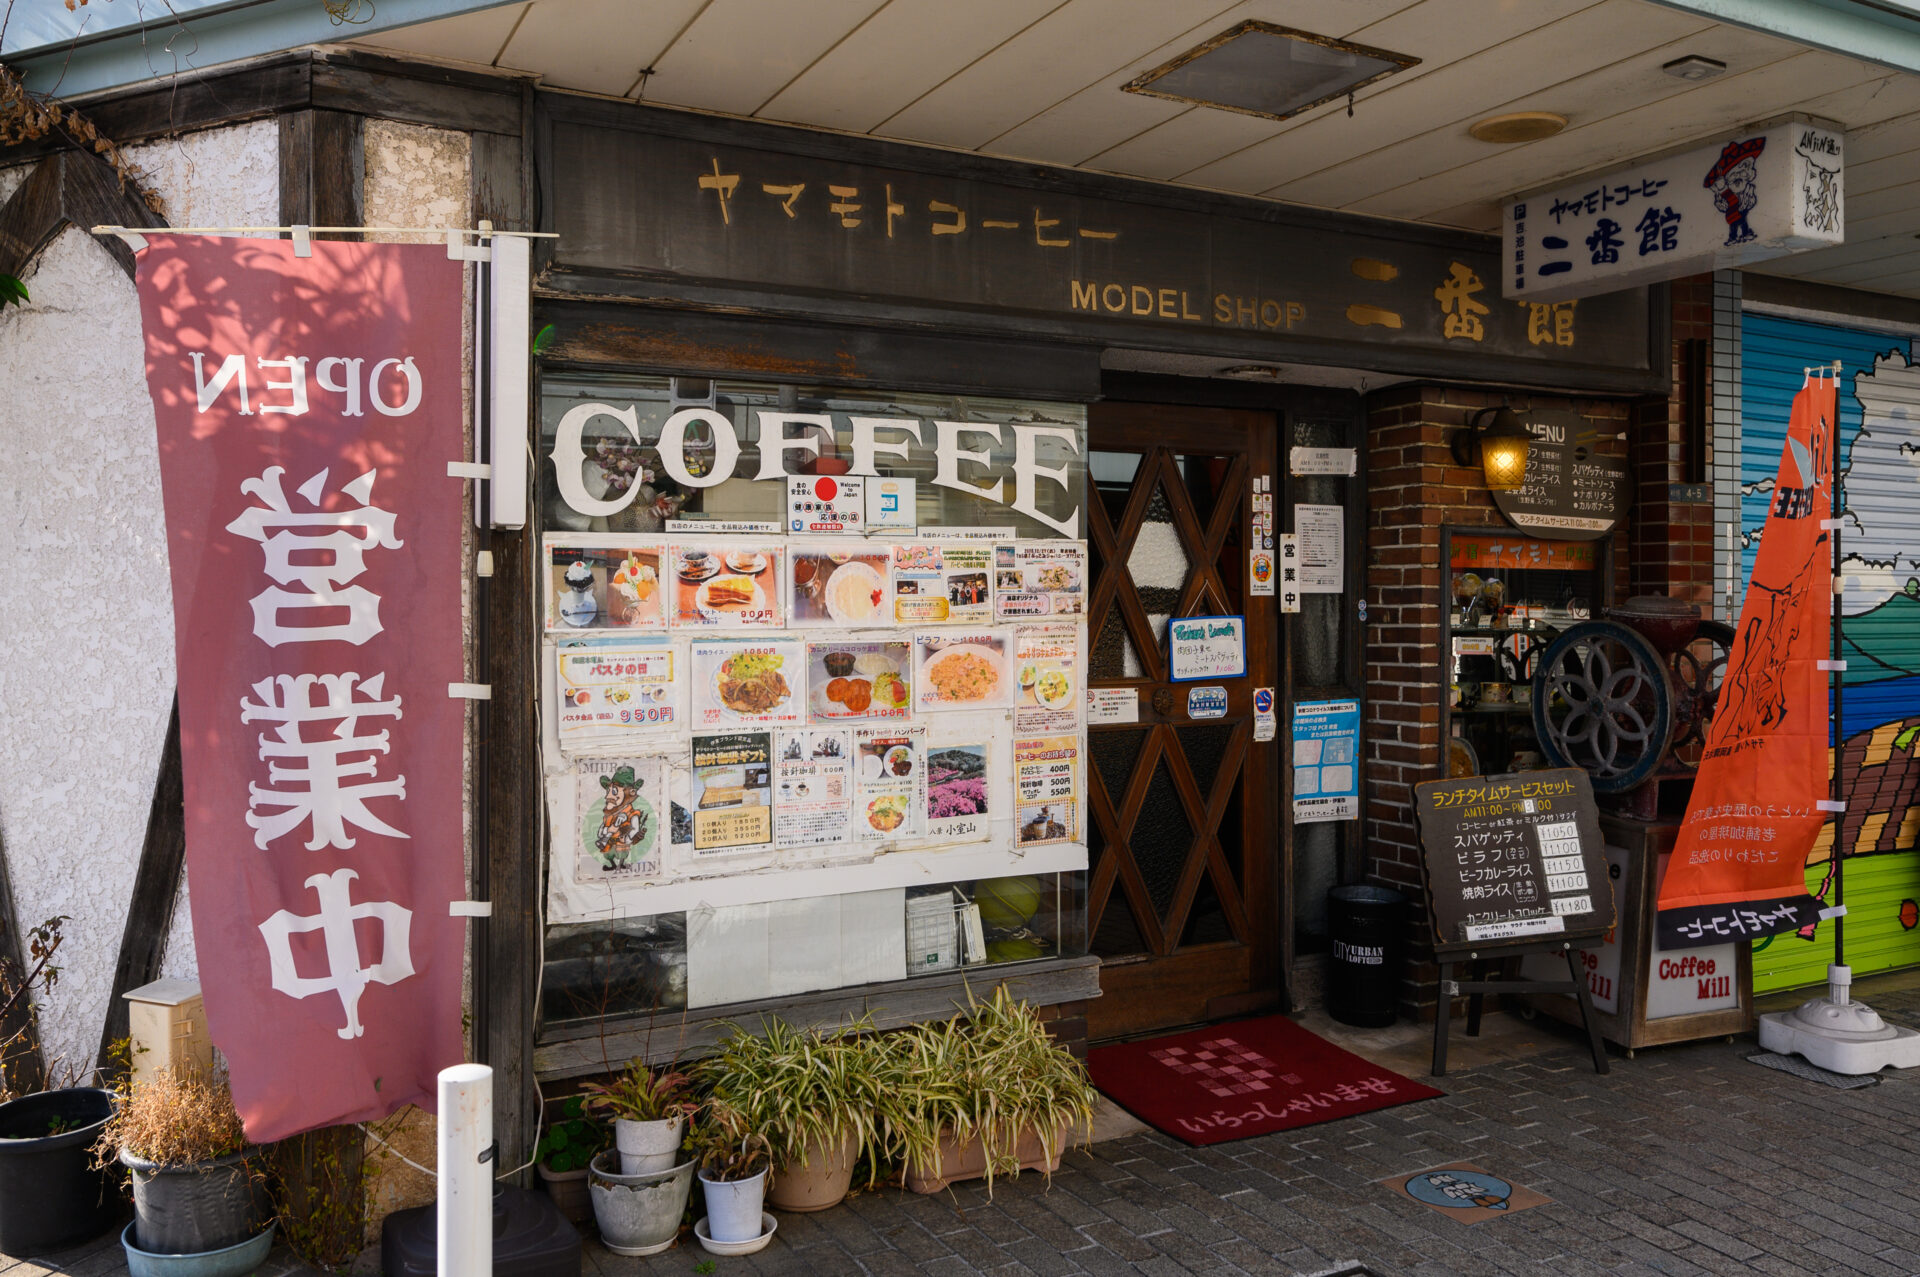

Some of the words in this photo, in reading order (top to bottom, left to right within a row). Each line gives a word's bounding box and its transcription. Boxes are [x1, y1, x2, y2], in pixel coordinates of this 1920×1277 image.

[698, 158, 1117, 247] ヤマモトコーヒー
[1549, 179, 1668, 224] ヤマモトコーヒー
[1538, 206, 1681, 276] 二番館
[1071, 279, 1201, 321] MODEL
[1214, 294, 1306, 330] SHOP
[1345, 257, 1577, 347] 二番館
[548, 402, 1080, 538] COFFEE
[1578, 478, 1616, 489] ミートソース
[1579, 490, 1615, 500] ナポリタン
[1579, 501, 1615, 512] カルボナーラ
[820, 512, 858, 522] 応援の店
[1490, 540, 1555, 566] ヤマモト
[1284, 543, 1296, 606] 営業中
[740, 610, 773, 619] 900円
[916, 636, 941, 645] ピラフ
[590, 663, 648, 676] パスタの日
[620, 707, 674, 722] 950円
[856, 729, 875, 737] 手作り
[894, 727, 926, 736] ハンバーグ
[583, 762, 627, 774] MIUR
[1049, 764, 1070, 773] 400円
[1050, 778, 1070, 786] 500円
[1051, 788, 1071, 796] 550円
[1432, 779, 1576, 807] ランチタイムサービスセット
[1454, 830, 1525, 849] スパゲッティ
[1457, 850, 1502, 865] ピラフ
[613, 861, 657, 875] ANJIN
[1459, 864, 1534, 883] ビーフカレーライス
[1462, 884, 1512, 900] 焼肉ライス
[1466, 906, 1546, 924] カニクリームコロッケ
[1333, 939, 1351, 961] CITY
[1351, 945, 1384, 957] URBAN
[1349, 955, 1367, 964] LOFT
[1659, 955, 1716, 981] Coffee
[1586, 971, 1612, 1001] ill
[1697, 976, 1731, 1000] Mill
[1177, 1077, 1397, 1133] いらっしゃいませ
